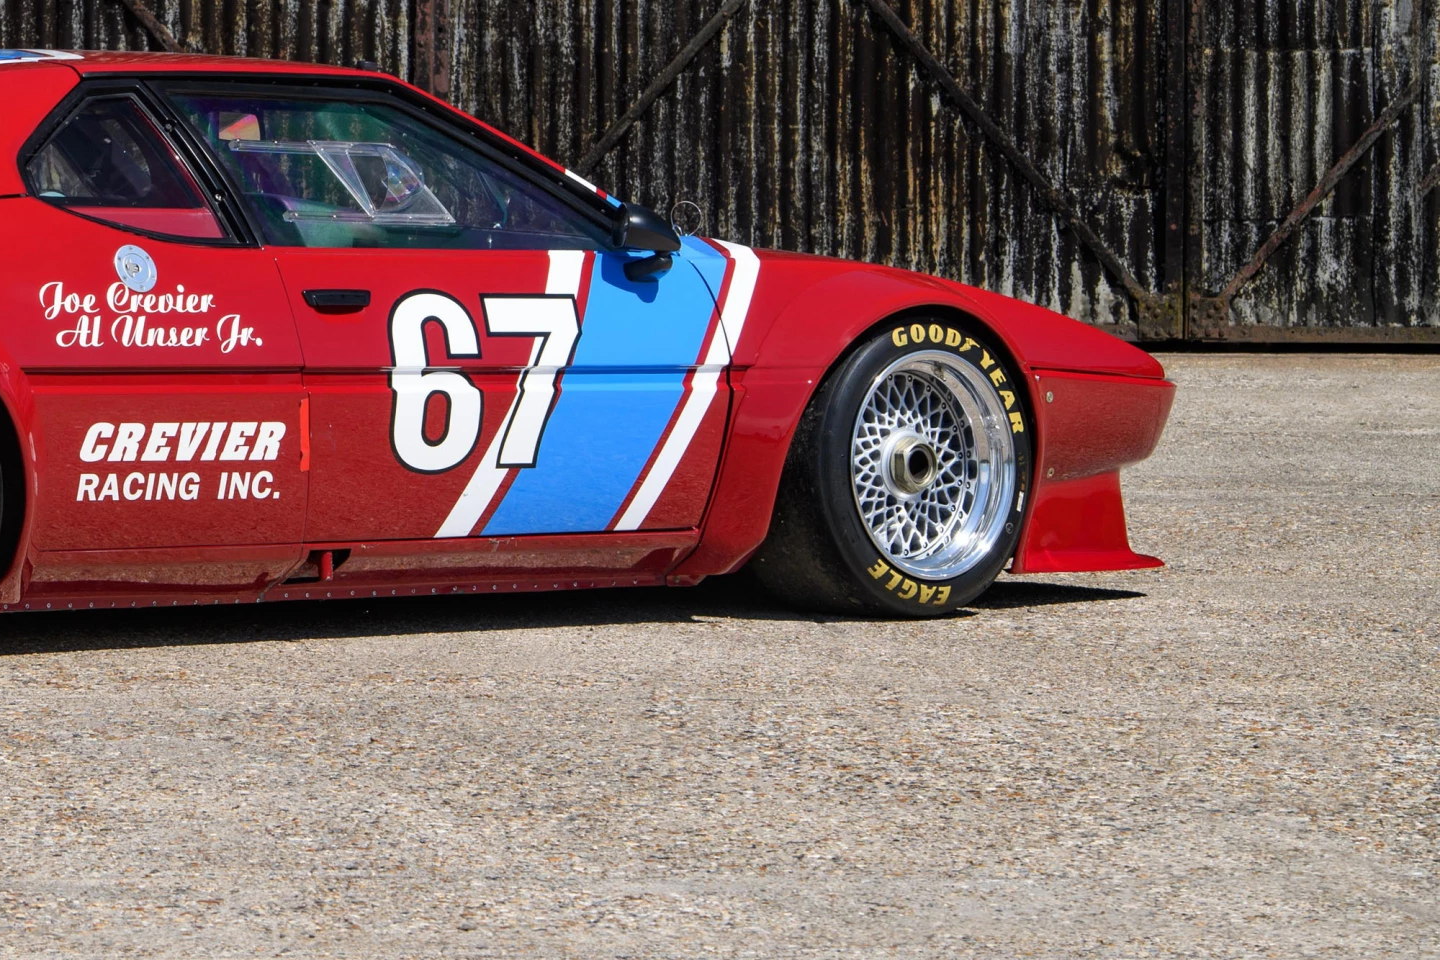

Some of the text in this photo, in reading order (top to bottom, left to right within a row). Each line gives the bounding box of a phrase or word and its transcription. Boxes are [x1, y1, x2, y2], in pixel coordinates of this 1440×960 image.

[39, 281, 216, 320] Joe Crevier
[56, 314, 263, 354] Al Unser Jr.
[388, 288, 582, 474] 67
[891, 323, 1025, 435] GOODYEAR
[79, 421, 286, 462] CREVIER
[76, 471, 280, 501] RACING INC.
[867, 558, 952, 606] EAGLE
